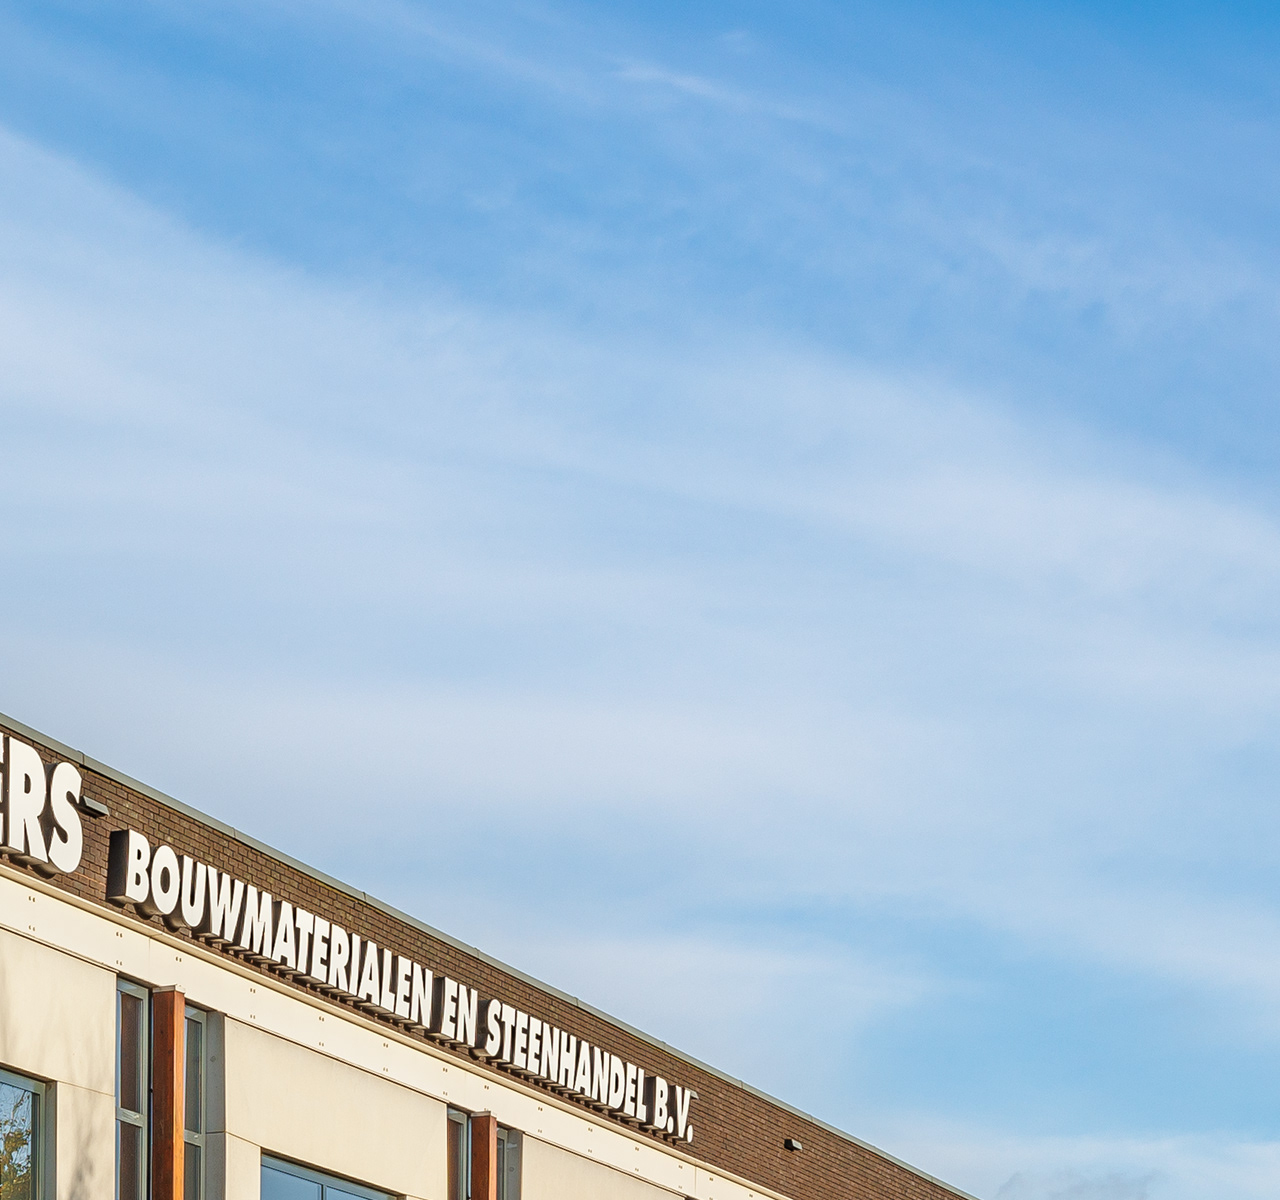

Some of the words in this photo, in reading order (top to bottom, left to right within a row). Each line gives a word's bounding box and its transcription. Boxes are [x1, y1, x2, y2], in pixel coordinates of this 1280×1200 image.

[125, 829, 434, 1029] BOUWMATERIALEN
[441, 976, 478, 1048] EN
[485, 999, 647, 1124] STEENHANDEL
[653, 1076, 694, 1143] B.V.
